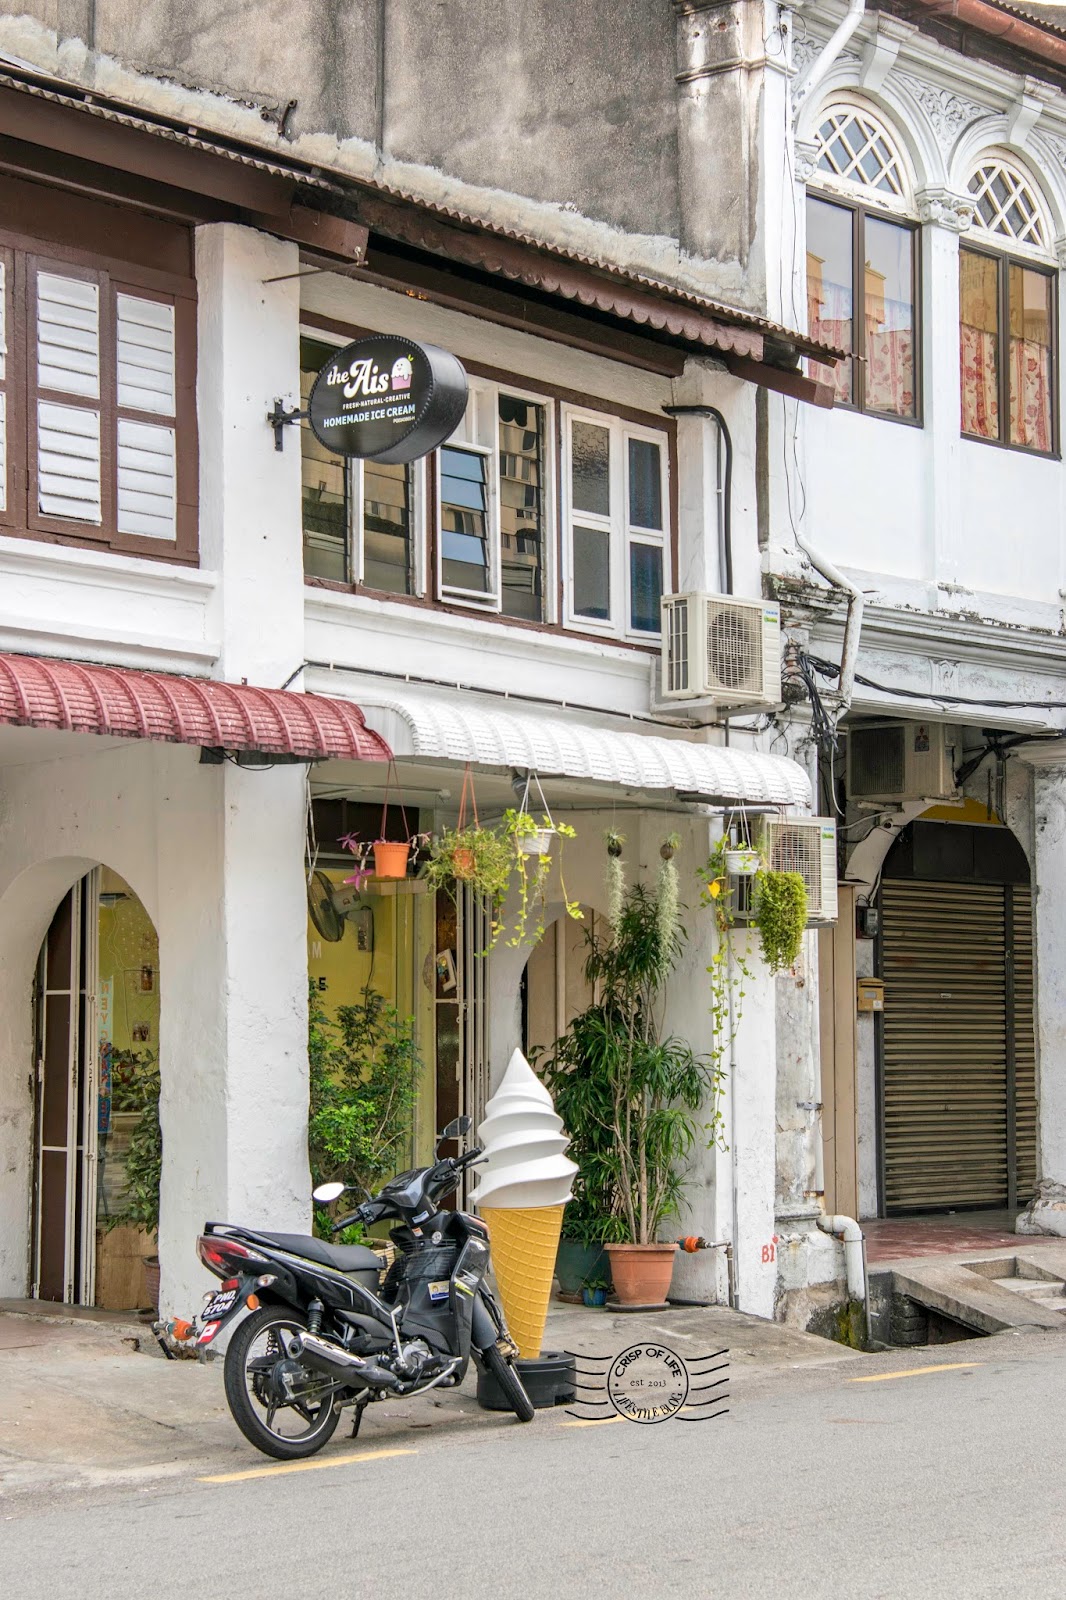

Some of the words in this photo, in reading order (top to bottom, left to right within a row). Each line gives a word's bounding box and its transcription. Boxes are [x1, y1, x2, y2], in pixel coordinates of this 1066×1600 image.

[327, 365, 349, 386] the
[343, 358, 389, 398] Ais
[323, 411, 370, 428] HOMEMADE
[370, 409, 386, 420] ICE
[386, 404, 416, 418] CREAM
